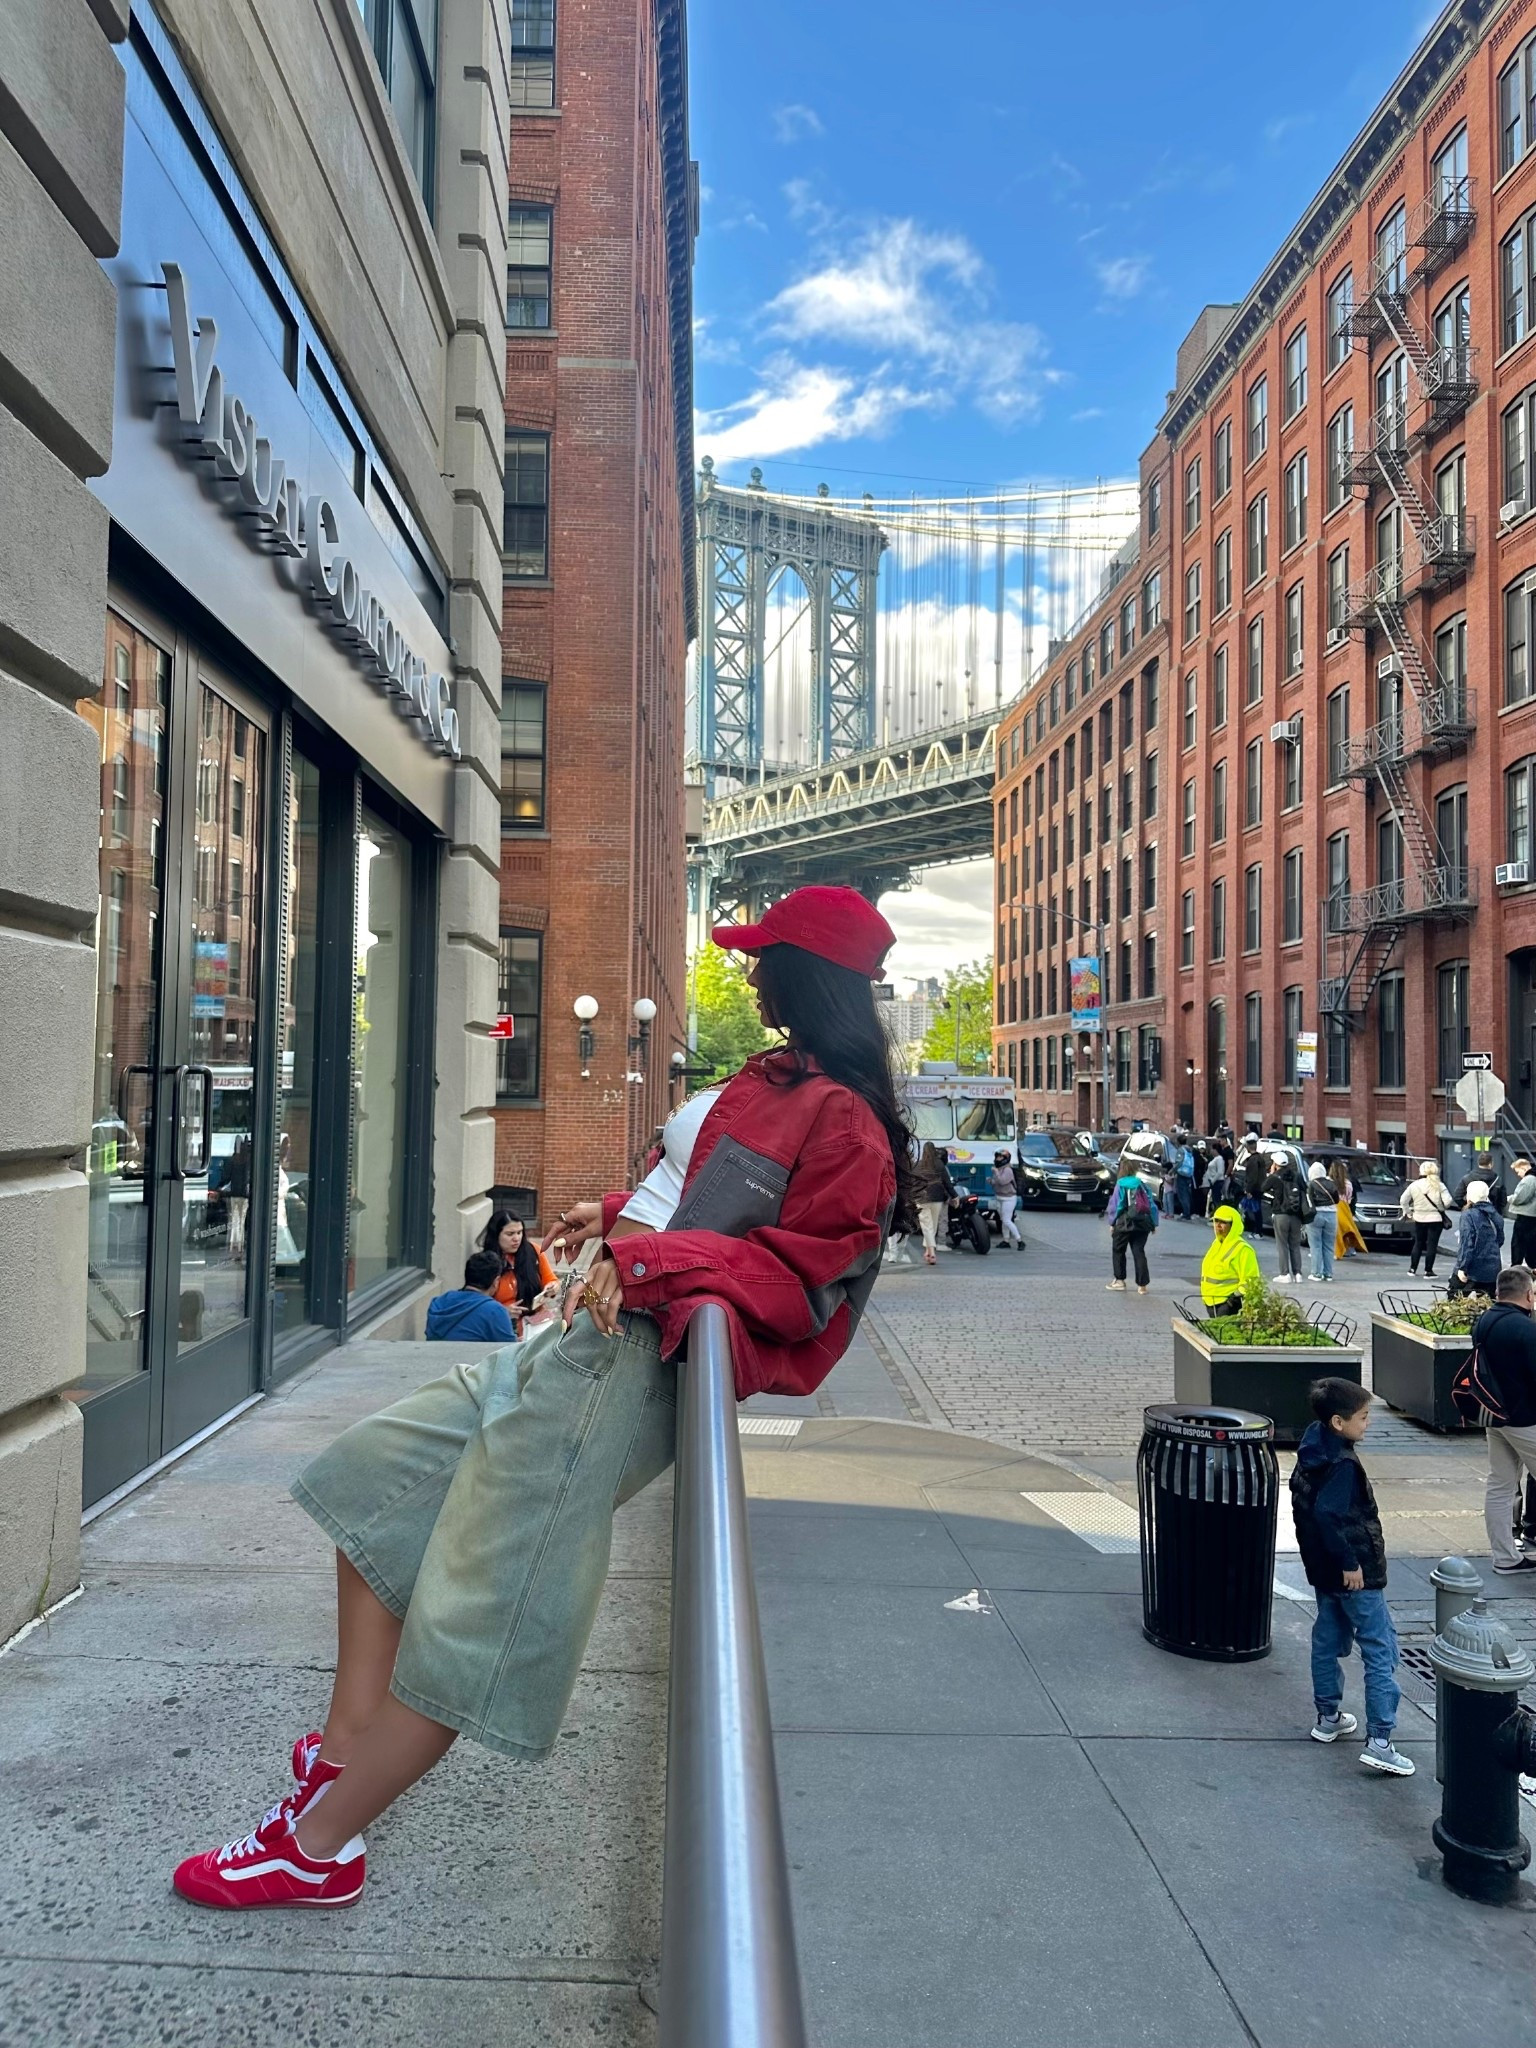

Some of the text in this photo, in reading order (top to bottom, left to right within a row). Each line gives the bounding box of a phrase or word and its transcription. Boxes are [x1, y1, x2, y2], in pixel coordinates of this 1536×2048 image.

[1467, 1058, 1475, 1066] ONE
[915, 1085, 939, 1095] CREAM
[969, 1087, 1006, 1096] ICE CREAM
[745, 1179, 775, 1199] supreme
[1167, 1424, 1182, 1435] YOUR
[1182, 1427, 1213, 1439] DISPOSAL
